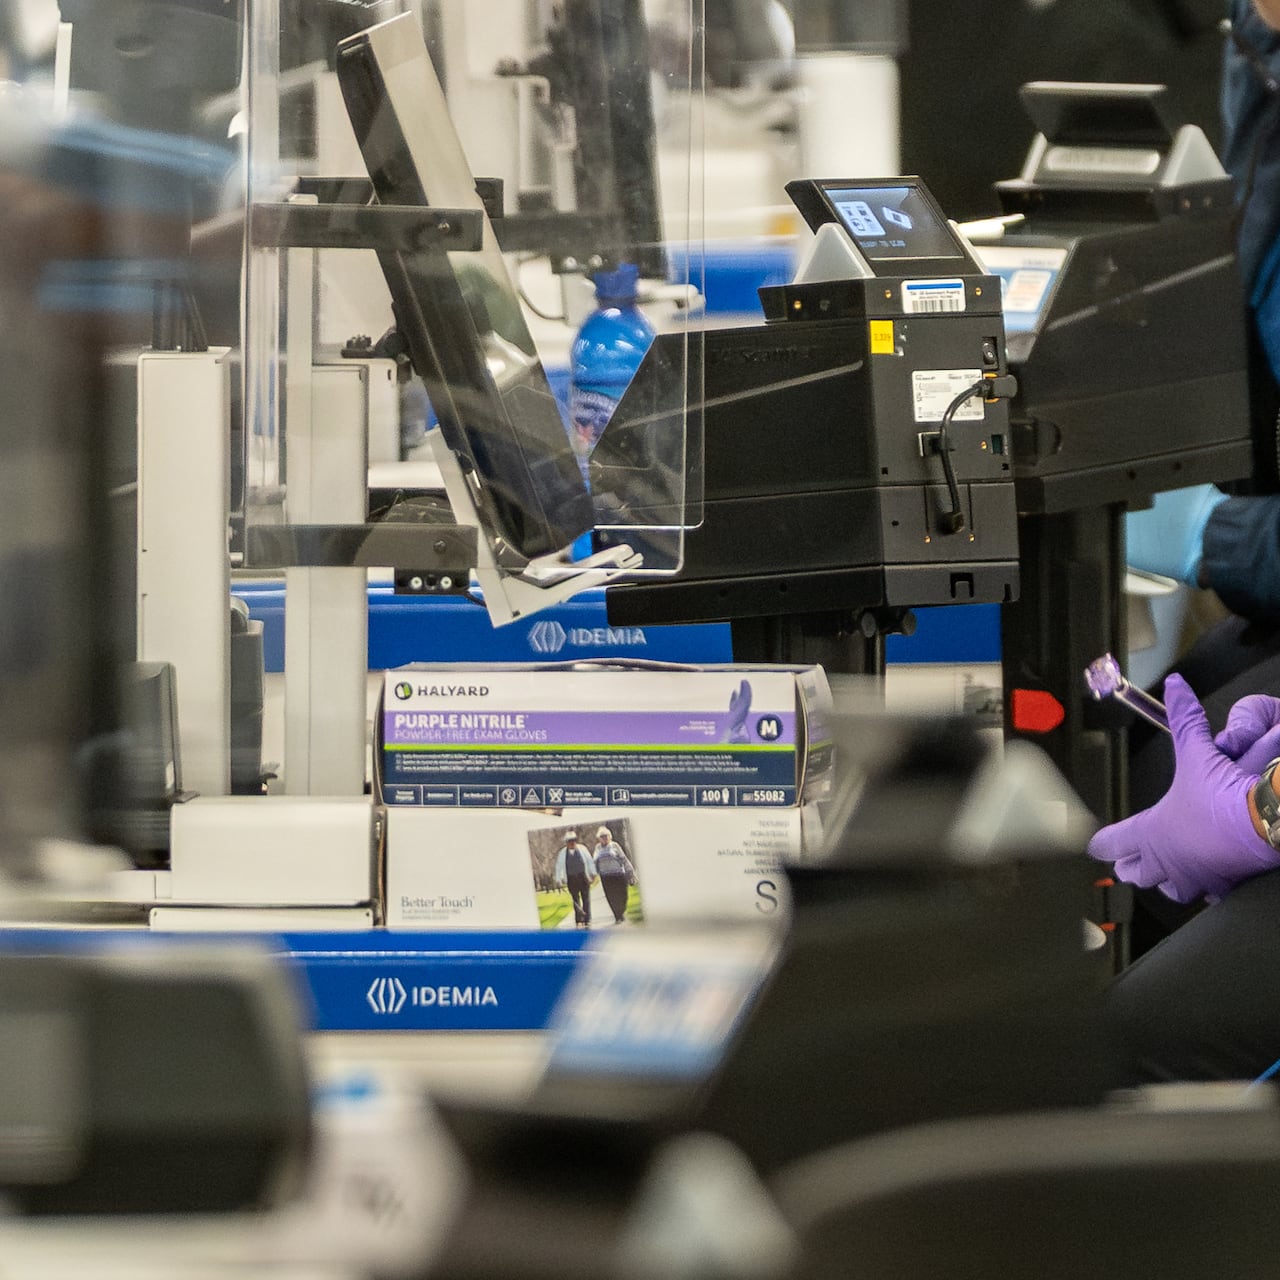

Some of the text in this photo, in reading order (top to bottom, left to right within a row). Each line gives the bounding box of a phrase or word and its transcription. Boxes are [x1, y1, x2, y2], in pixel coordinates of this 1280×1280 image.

[570, 627, 648, 646] IDEMIA
[417, 685, 490, 697] HALYARD
[394, 713, 458, 729] PURPLE
[760, 719, 778, 736] M
[394, 729, 548, 740] POWDER-FREE EXAM GLOVES
[701, 790, 721, 802] 100
[753, 790, 785, 802] 55082
[400, 895, 473, 909] Better Touch
[755, 879, 779, 915] S
[412, 986, 499, 1006] IDEMIA
